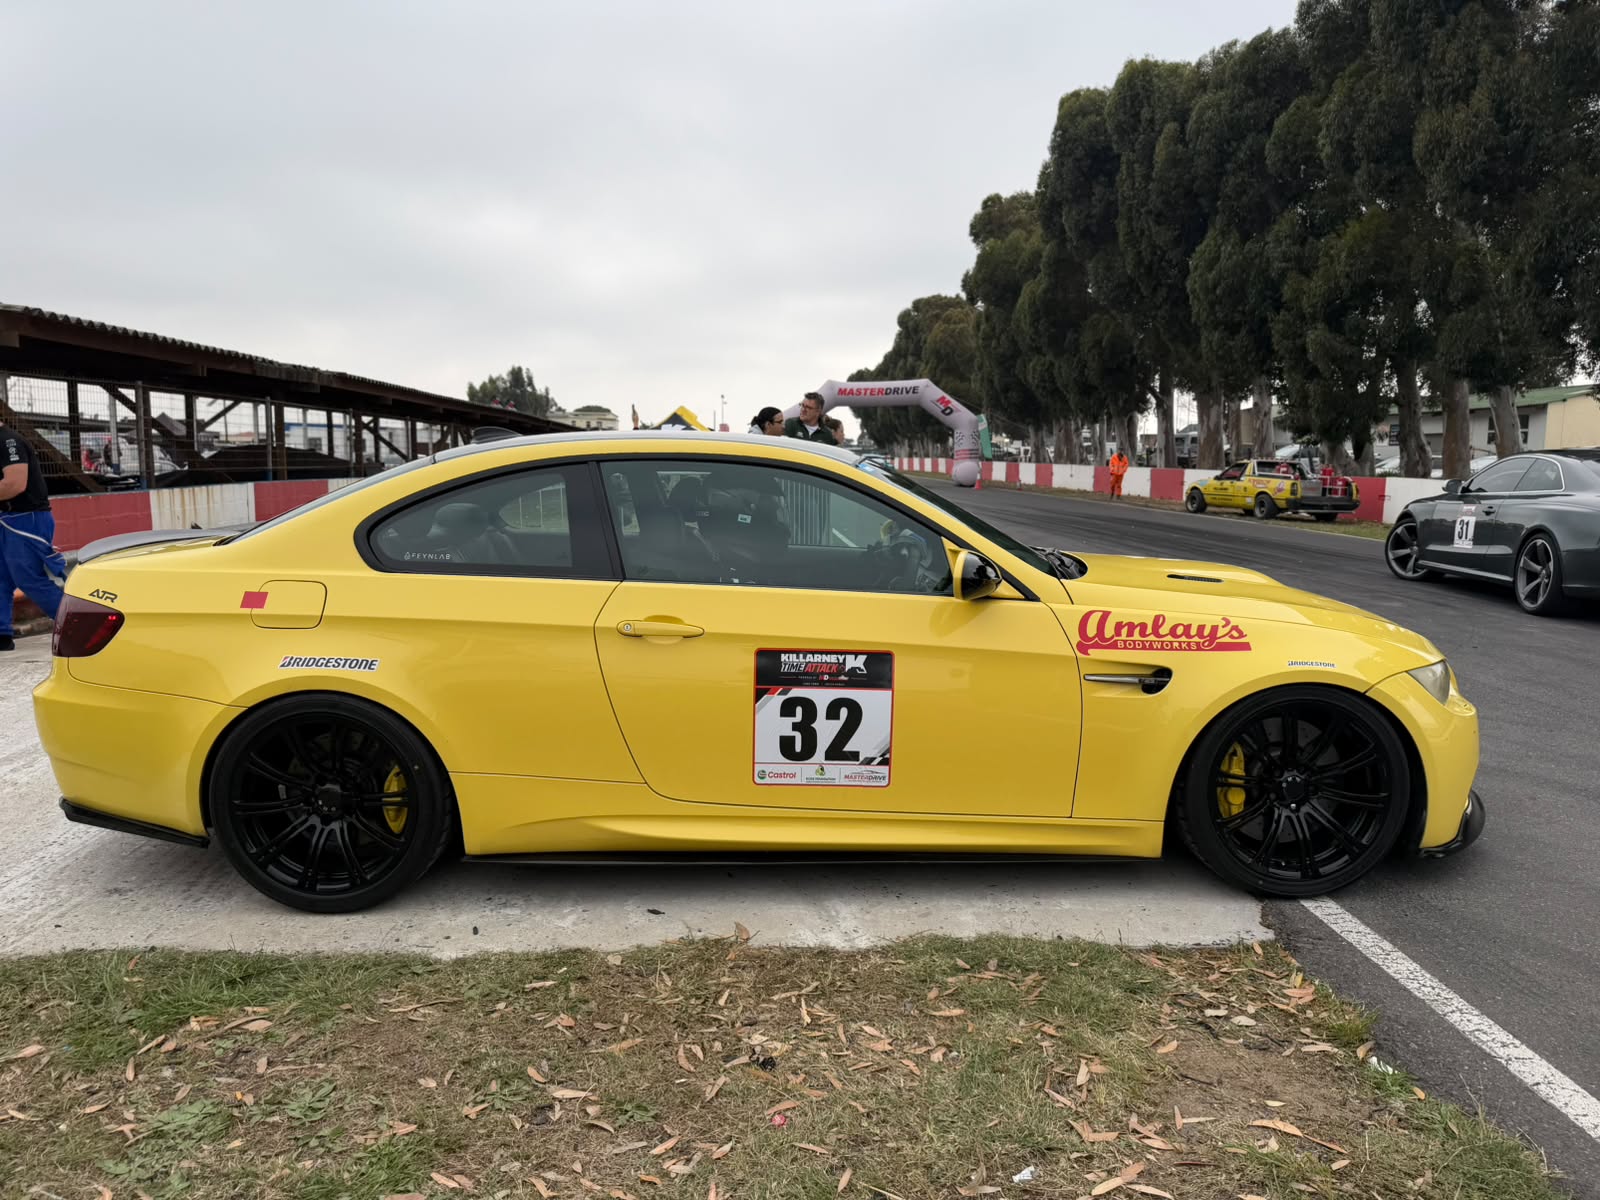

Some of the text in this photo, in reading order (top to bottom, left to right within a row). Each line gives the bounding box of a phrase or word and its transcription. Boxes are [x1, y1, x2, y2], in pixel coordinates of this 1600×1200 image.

[837, 385, 920, 397] MASTERDRIVE
[1457, 519, 1469, 540] 31
[411, 552, 451, 560] FEYNLAB
[89, 588, 118, 603] ATR
[1078, 609, 1248, 649] Amlay's
[1117, 640, 1197, 650] BODYWORKS
[781, 653, 845, 663] KILLARNEY
[280, 656, 378, 671] BRIDGESTONE
[780, 663, 838, 673] TIME ATTACK
[1287, 660, 1336, 668] BRIDGESTONE
[779, 696, 863, 762] 32
[767, 771, 797, 779] Castrol
[844, 774, 887, 782] MASTERDRIVE
